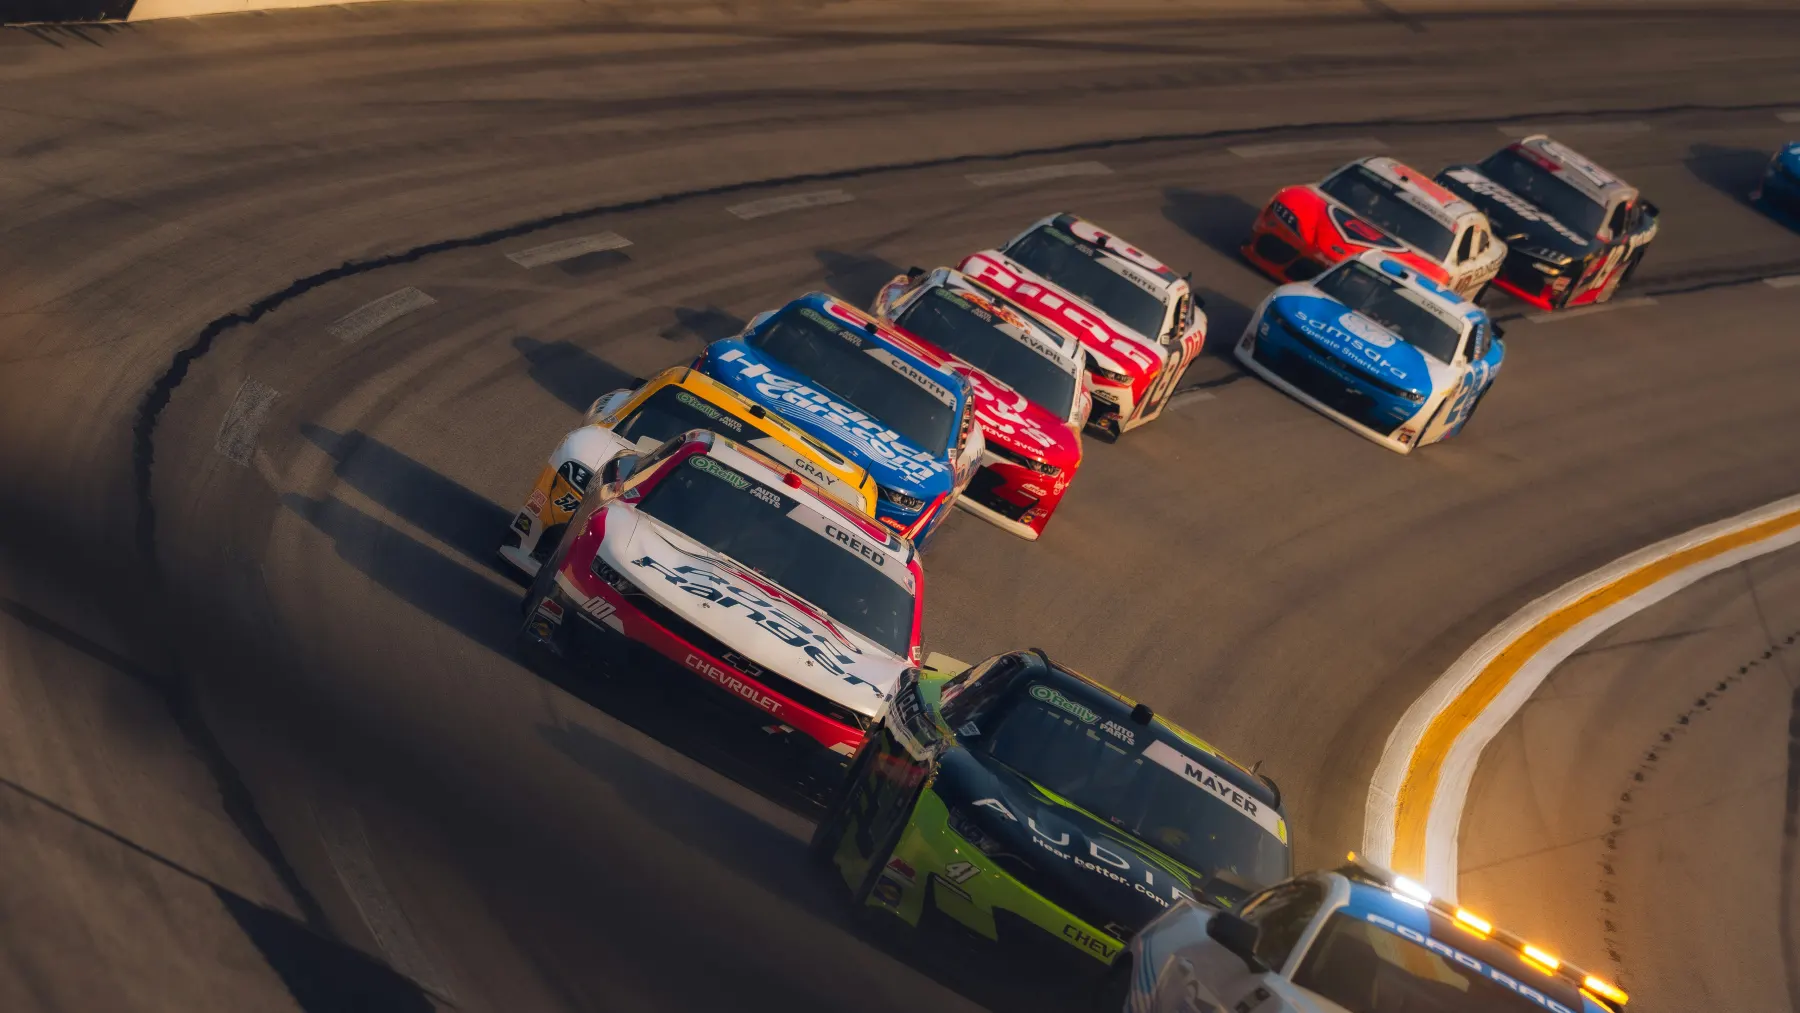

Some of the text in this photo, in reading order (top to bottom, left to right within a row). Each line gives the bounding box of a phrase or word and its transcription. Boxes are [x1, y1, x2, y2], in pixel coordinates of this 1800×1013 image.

[1121, 269, 1156, 292] SMITH
[1020, 333, 1065, 366] KVAPIL
[1295, 311, 1408, 380] samsara
[1301, 325, 1381, 375] Operate Smarter
[891, 359, 945, 397] CARUTH
[676, 392, 721, 419] O'Reilly
[719, 349, 952, 474] Hendrick
[723, 416, 742, 428] AUTO
[719, 417, 742, 433] PARTS
[688, 454, 751, 490] O'Reilly
[795, 458, 836, 486] GRAY
[750, 488, 781, 509] PARTS
[754, 486, 781, 502] AUTO
[825, 524, 885, 568] CREED
[581, 596, 616, 620] 00
[673, 565, 856, 665] Road
[632, 556, 886, 697] Ranger
[685, 653, 782, 714] CHEVROLET
[1029, 684, 1100, 724] O'Reilly
[1101, 722, 1135, 746] PARTS
[1105, 719, 1135, 738] AUTO
[1184, 763, 1258, 817] MAYER
[945, 860, 982, 885] 41
[1032, 835, 1071, 861] Hear
[1073, 855, 1131, 887] better.
[1367, 913, 1483, 973] FORD
